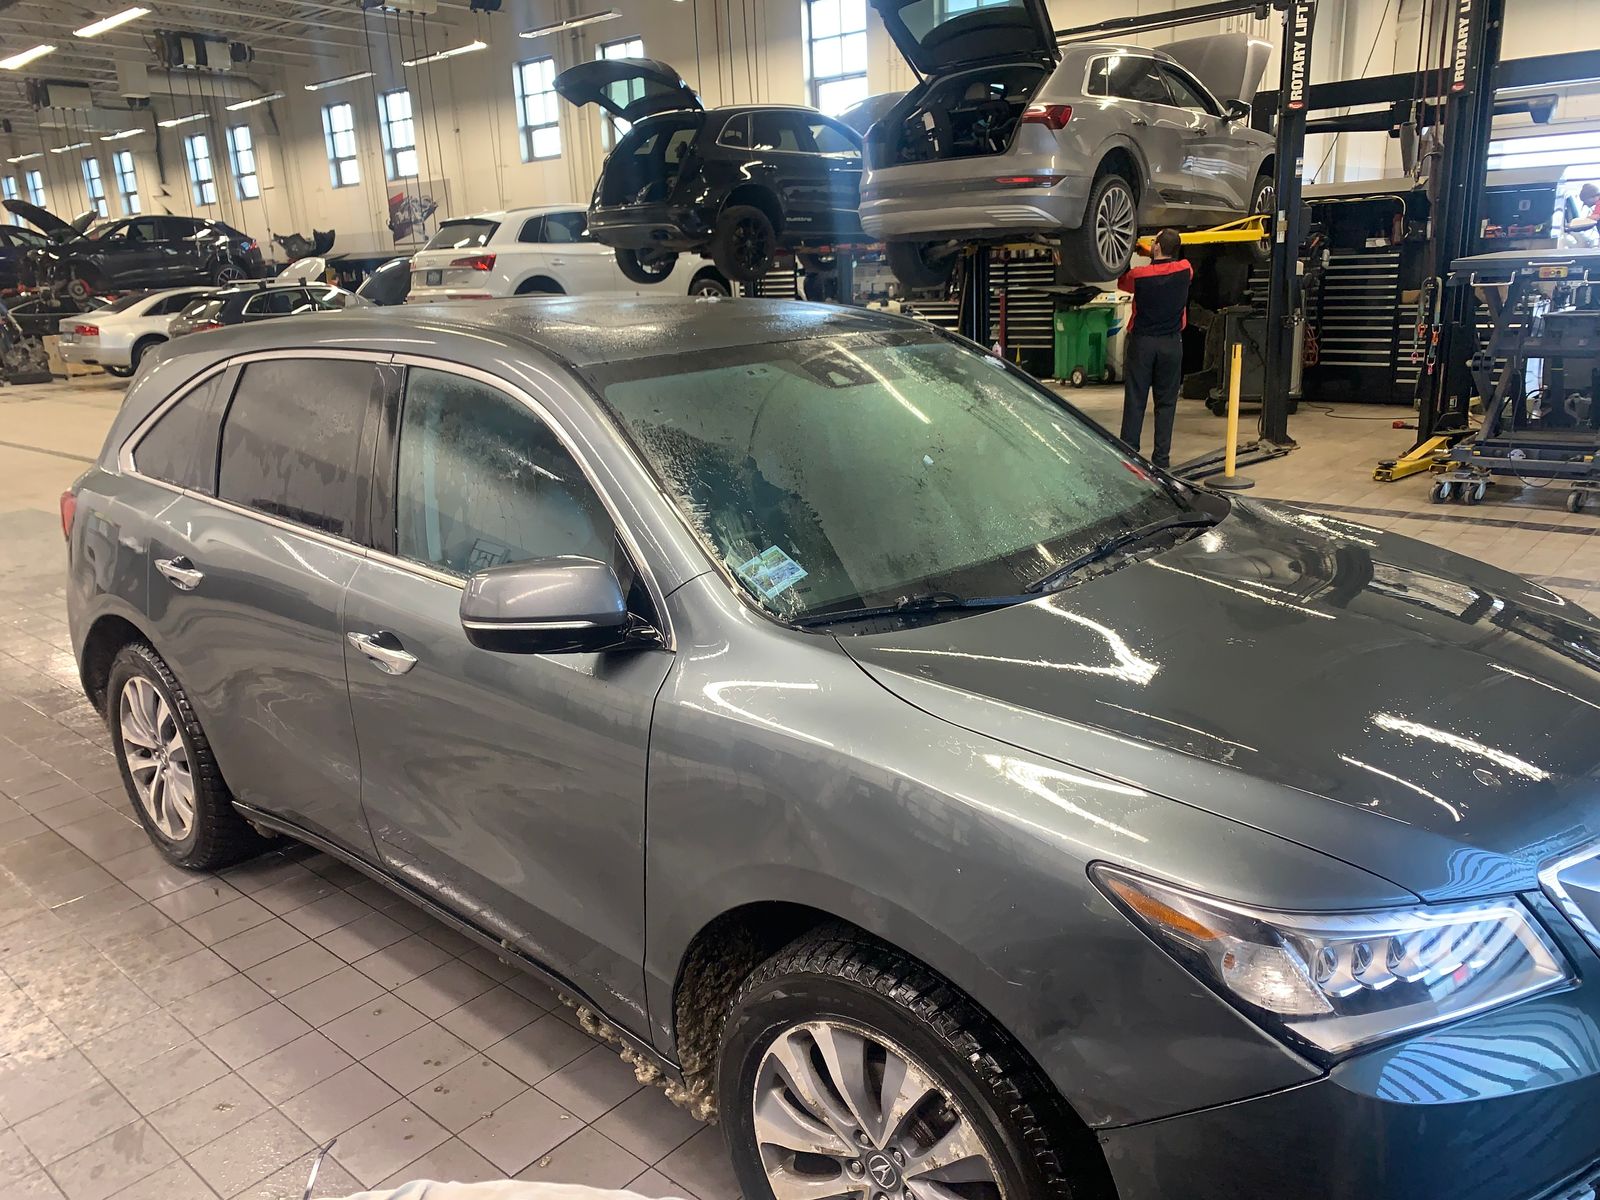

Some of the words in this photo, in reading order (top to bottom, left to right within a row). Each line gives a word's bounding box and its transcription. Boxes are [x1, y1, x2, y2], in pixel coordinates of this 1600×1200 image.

[1294, 4, 1309, 37] LIFT
[1454, 17, 1470, 82] ROTARY
[1290, 41, 1306, 101] ROTARY
